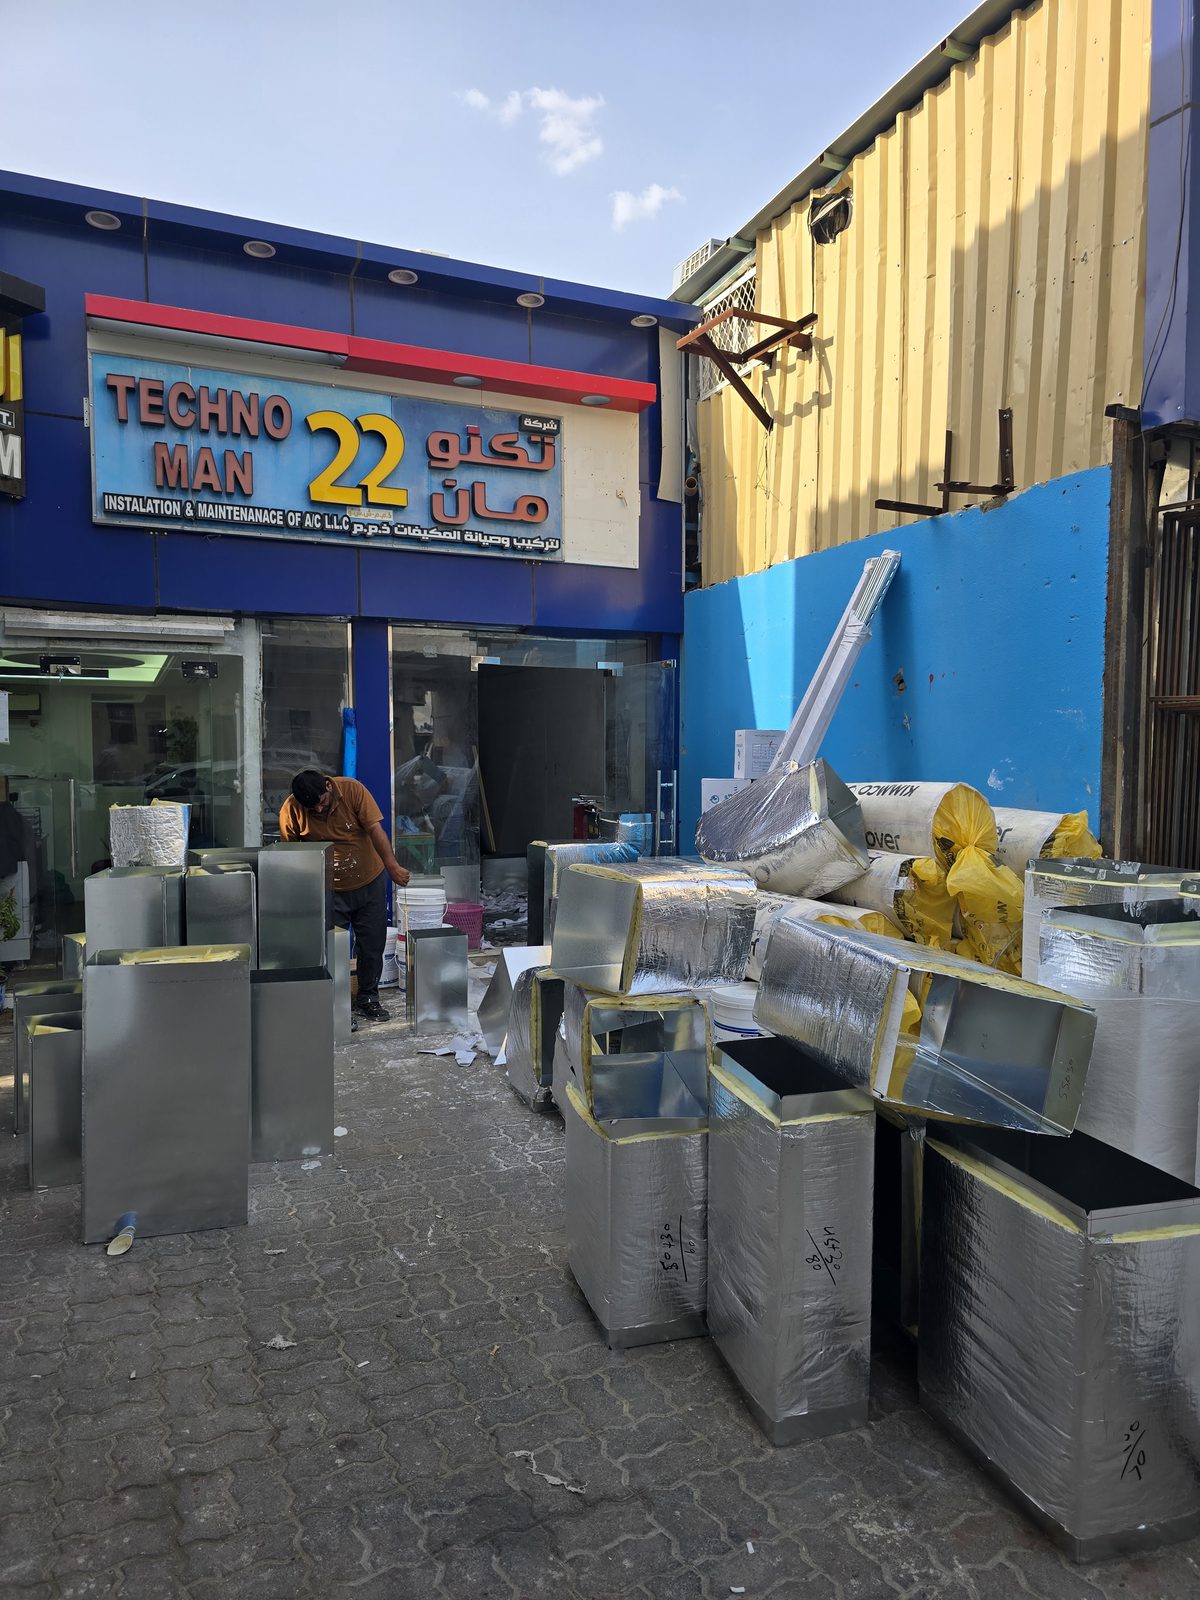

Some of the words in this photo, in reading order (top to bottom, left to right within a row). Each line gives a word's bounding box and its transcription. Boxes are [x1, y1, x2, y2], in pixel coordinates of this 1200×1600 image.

[106, 373, 293, 441] TECHNO
[524, 418, 557, 431] شركة
[304, 410, 408, 507] 22
[426, 425, 556, 471] تكنو
[153, 441, 254, 496] MAN
[104, 494, 181, 516] INSTALATION
[185, 502, 194, 517] &
[198, 503, 283, 525] MAINTENANACE
[287, 512, 302, 527] OF
[304, 513, 321, 529] A/C
[325, 516, 350, 531] L.L.C
[430, 479, 549, 525] مان
[394, 524, 460, 540] المكيفات
[464, 531, 510, 547] وصيانة
[513, 537, 560, 551] لتركيب
[858, 785, 920, 797] KIMMCO
